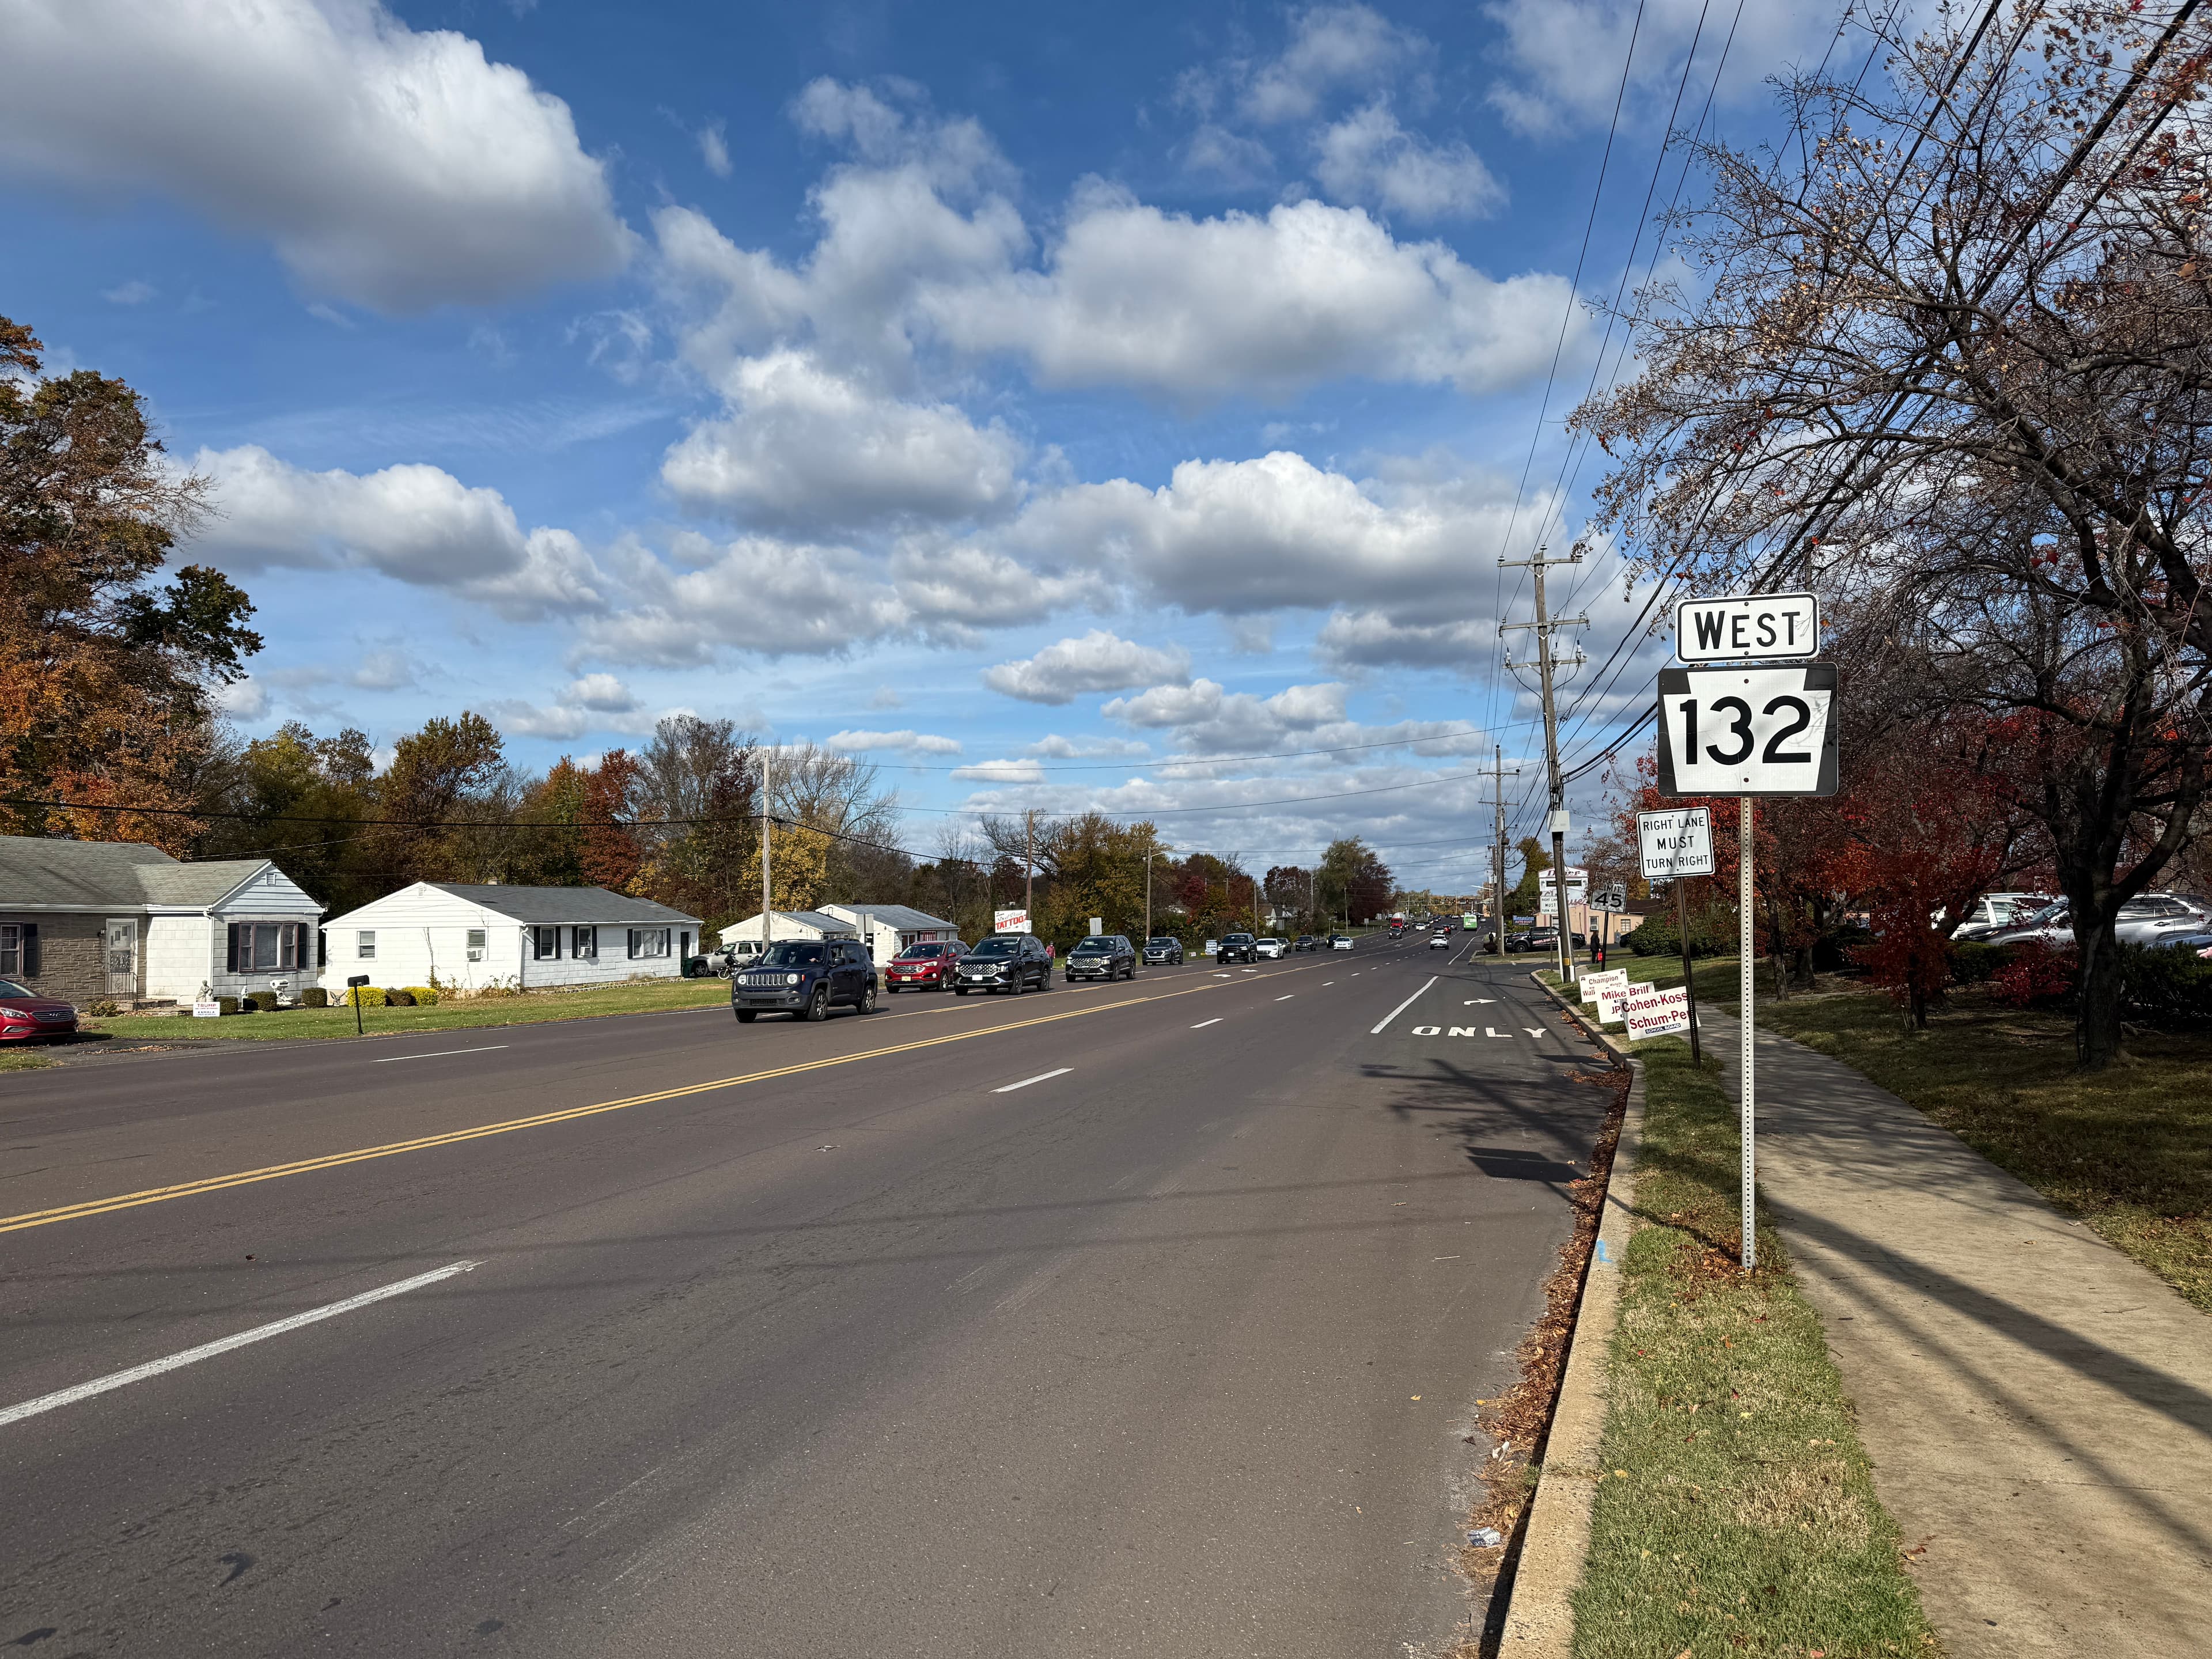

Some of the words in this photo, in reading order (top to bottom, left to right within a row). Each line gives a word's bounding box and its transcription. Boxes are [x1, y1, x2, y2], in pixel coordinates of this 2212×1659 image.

[1694, 611, 1800, 650] WEST
[1680, 695, 1811, 765] 132
[1643, 820, 1673, 831] RIGHT
[1678, 817, 1705, 828] LANE
[1657, 836, 1694, 850] MUST
[1646, 858, 1672, 869] TURN
[1679, 855, 1708, 866] RIGHT
[1599, 884, 1621, 892] LIMIT
[1594, 892, 1622, 907] 45
[1589, 976, 1619, 985] Champion
[1601, 990, 1627, 1000] Mike
[1629, 985, 1649, 996] Brill
[1612, 1006, 1620, 1014] JP
[1411, 1026, 1547, 1037] ONLY
